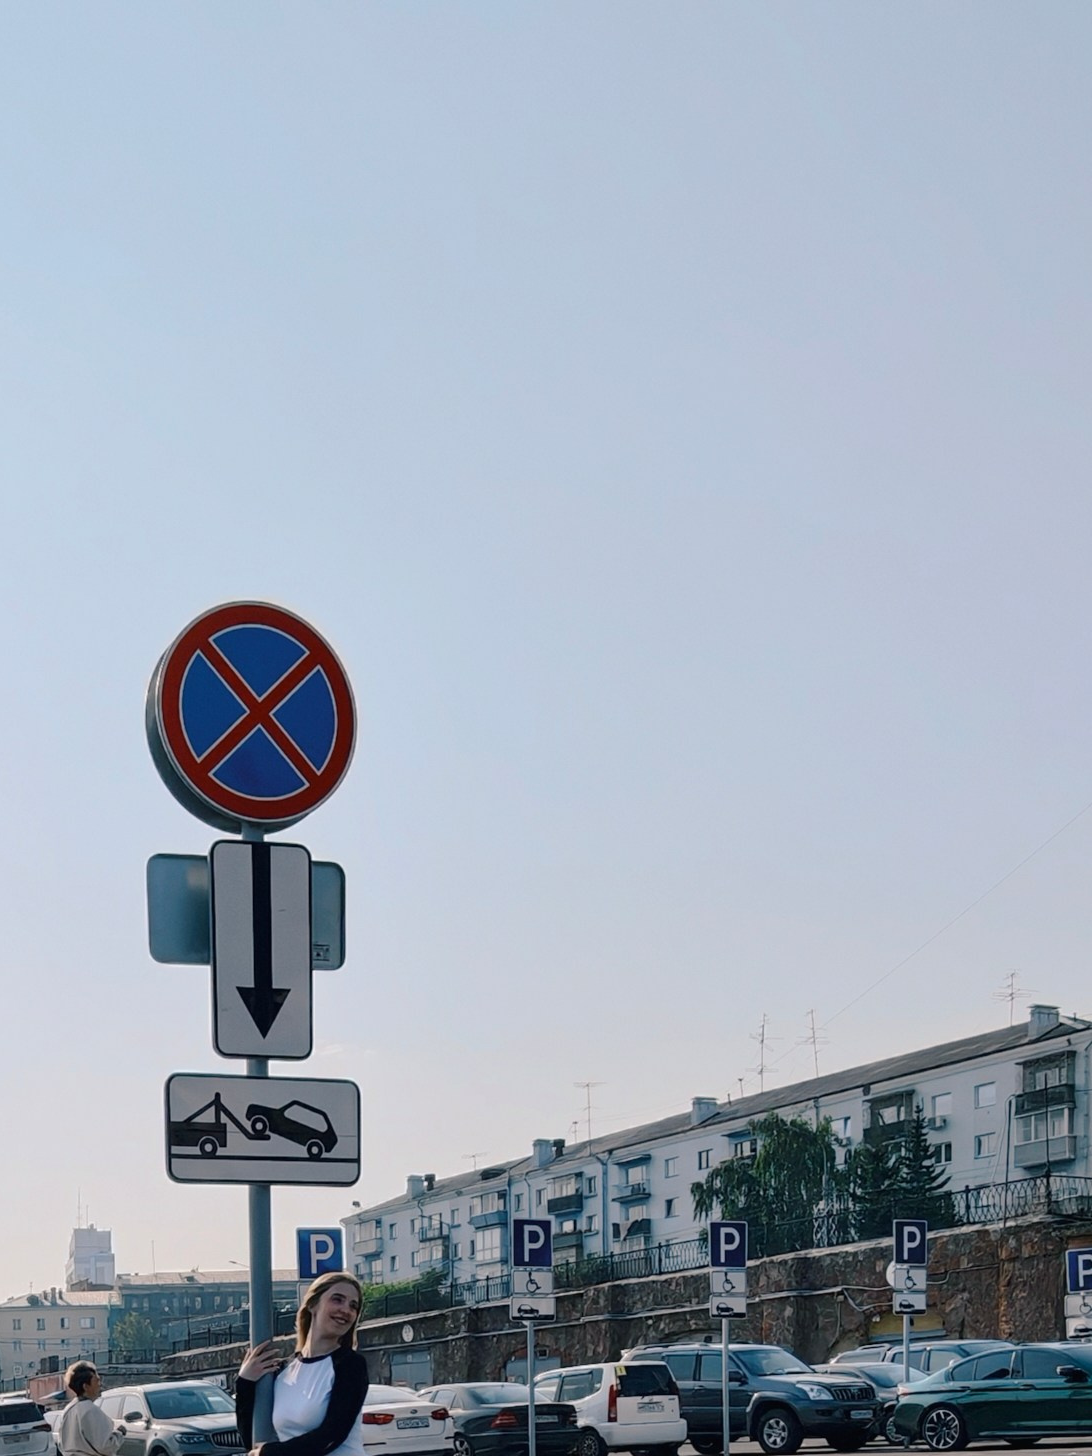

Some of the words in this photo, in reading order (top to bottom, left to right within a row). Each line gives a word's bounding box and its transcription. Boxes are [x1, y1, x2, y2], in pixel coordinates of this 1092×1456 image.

[310, 1233, 335, 1274] P
[523, 1224, 545, 1262] P
[719, 1226, 740, 1263] P
[902, 1225, 921, 1260] P
[1077, 1254, 1092, 1288] P
